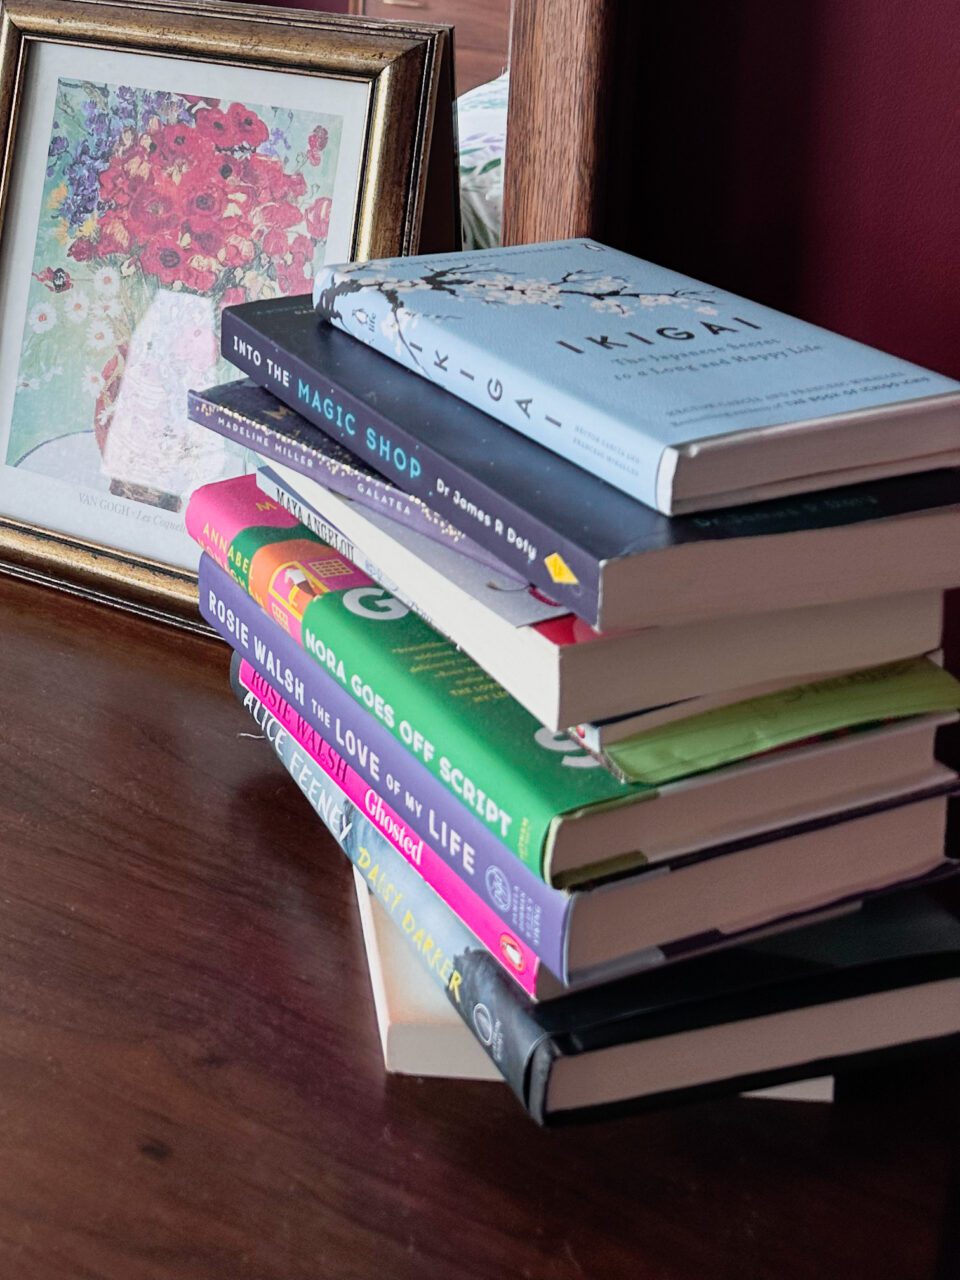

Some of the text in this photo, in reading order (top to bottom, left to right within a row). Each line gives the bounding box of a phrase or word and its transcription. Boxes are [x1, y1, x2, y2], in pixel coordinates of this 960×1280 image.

[556, 317, 762, 354] IKIGAI
[649, 346, 725, 363] Japanese
[726, 338, 781, 351] Secret
[699, 358, 731, 368] and
[731, 350, 788, 363] Happy
[788, 344, 823, 355] Life
[233, 335, 421, 478] INTO THE MAGIC SHOP
[409, 341, 562, 428] IKIGAI
[218, 417, 314, 468] MADELINE MILLER
[79, 492, 97, 507] VAN
[100, 499, 129, 516] GOGH
[276, 488, 355, 561] MAYA ANGELOU
[357, 483, 411, 515] GALATEA
[436, 478, 537, 561] Dr James R Doty
[203, 522, 254, 581] ANNABEL
[209, 590, 248, 649] ROSIE
[253, 635, 305, 706] WALSH
[311, 698, 330, 728] THE
[335, 718, 380, 781] LOVE
[386, 774, 401, 796] OF
[405, 791, 422, 818] MY
[429, 809, 475, 875] LIFE
[251, 670, 349, 784] ROSIE WALSH
[306, 629, 513, 838] NORA GOES OFF SCRIPT
[243, 691, 353, 841] ALICE FEENEY
[365, 789, 424, 866] Ghosted
[357, 847, 462, 1004] DAISY DARKER
